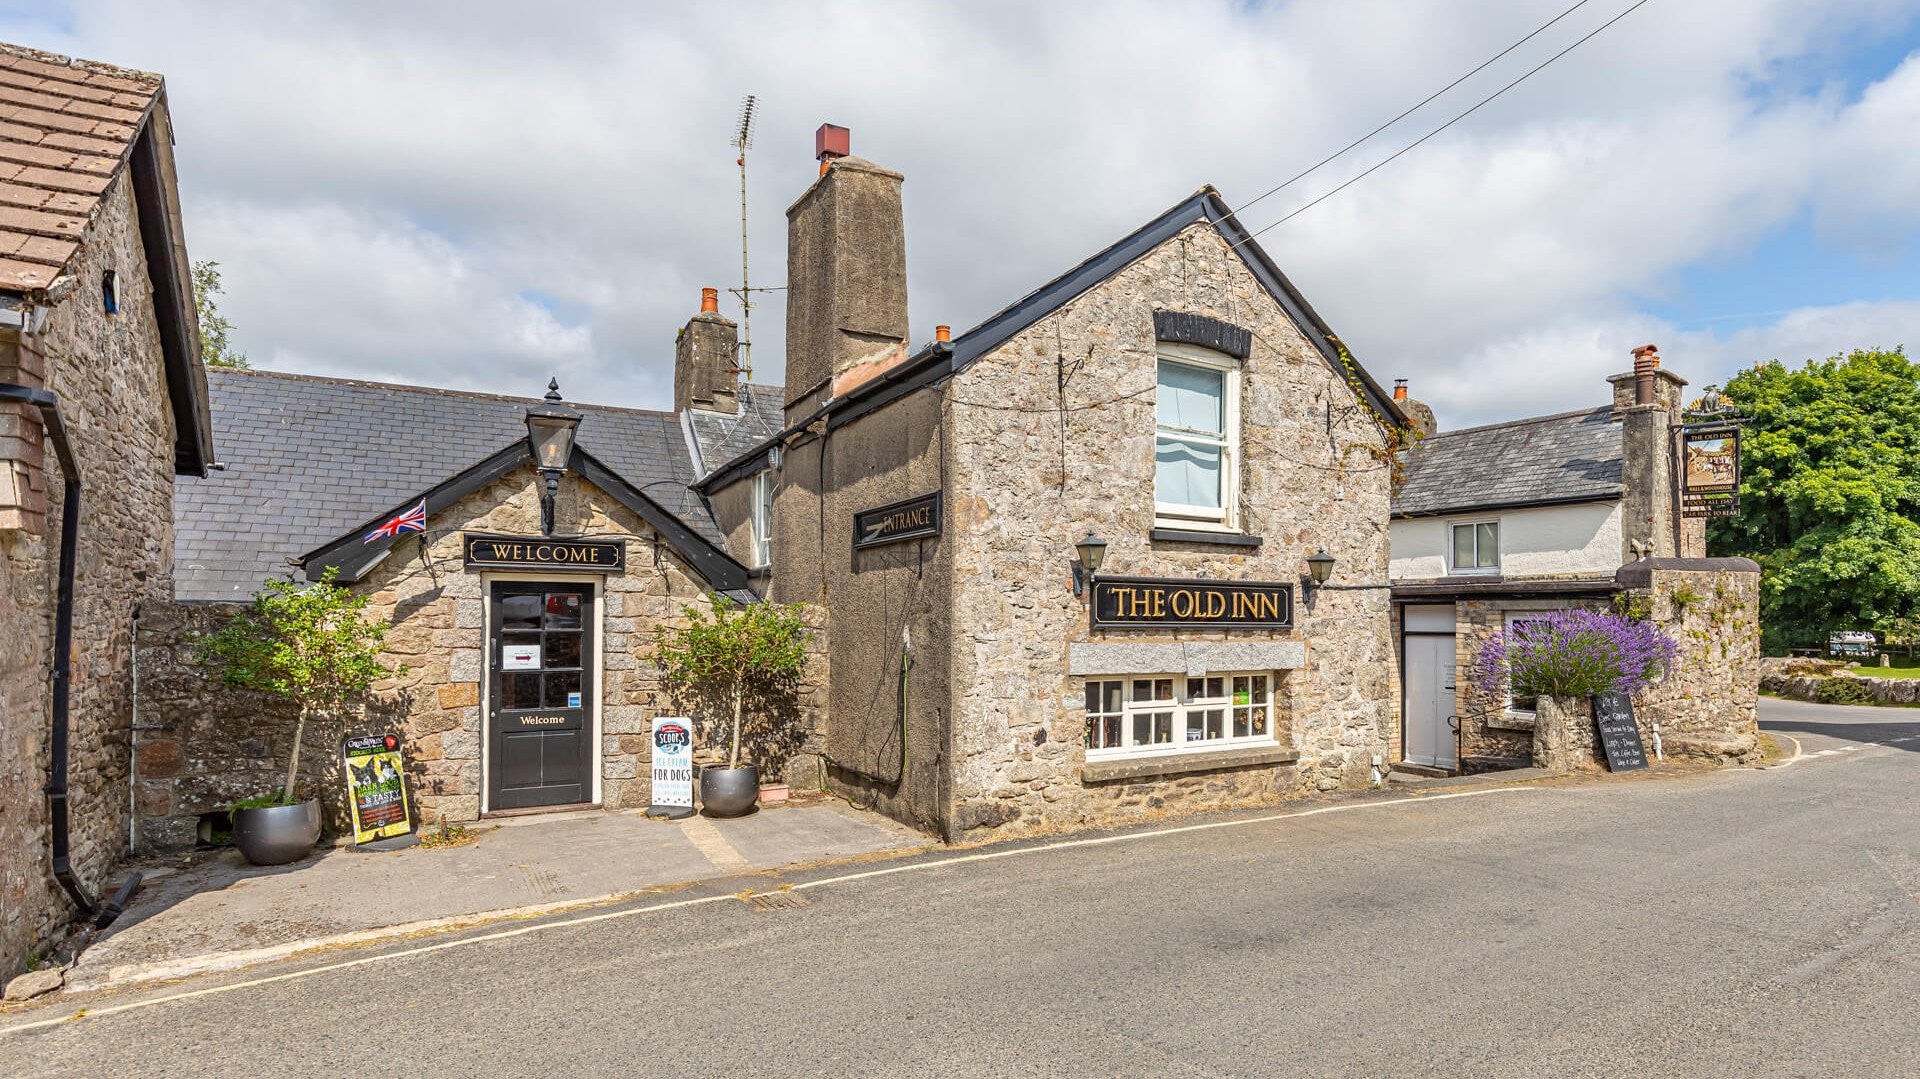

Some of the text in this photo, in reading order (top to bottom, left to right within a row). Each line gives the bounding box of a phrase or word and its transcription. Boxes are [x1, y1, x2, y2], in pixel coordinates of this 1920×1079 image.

[492, 544, 599, 562] WELCOME
[1109, 588, 1279, 619] THE OLD INN
[520, 716, 565, 725] Welcome
[656, 758, 688, 767] ICE CREAM
[654, 769, 691, 782] FOR DOGS
[373, 790, 400, 802] TASTY
